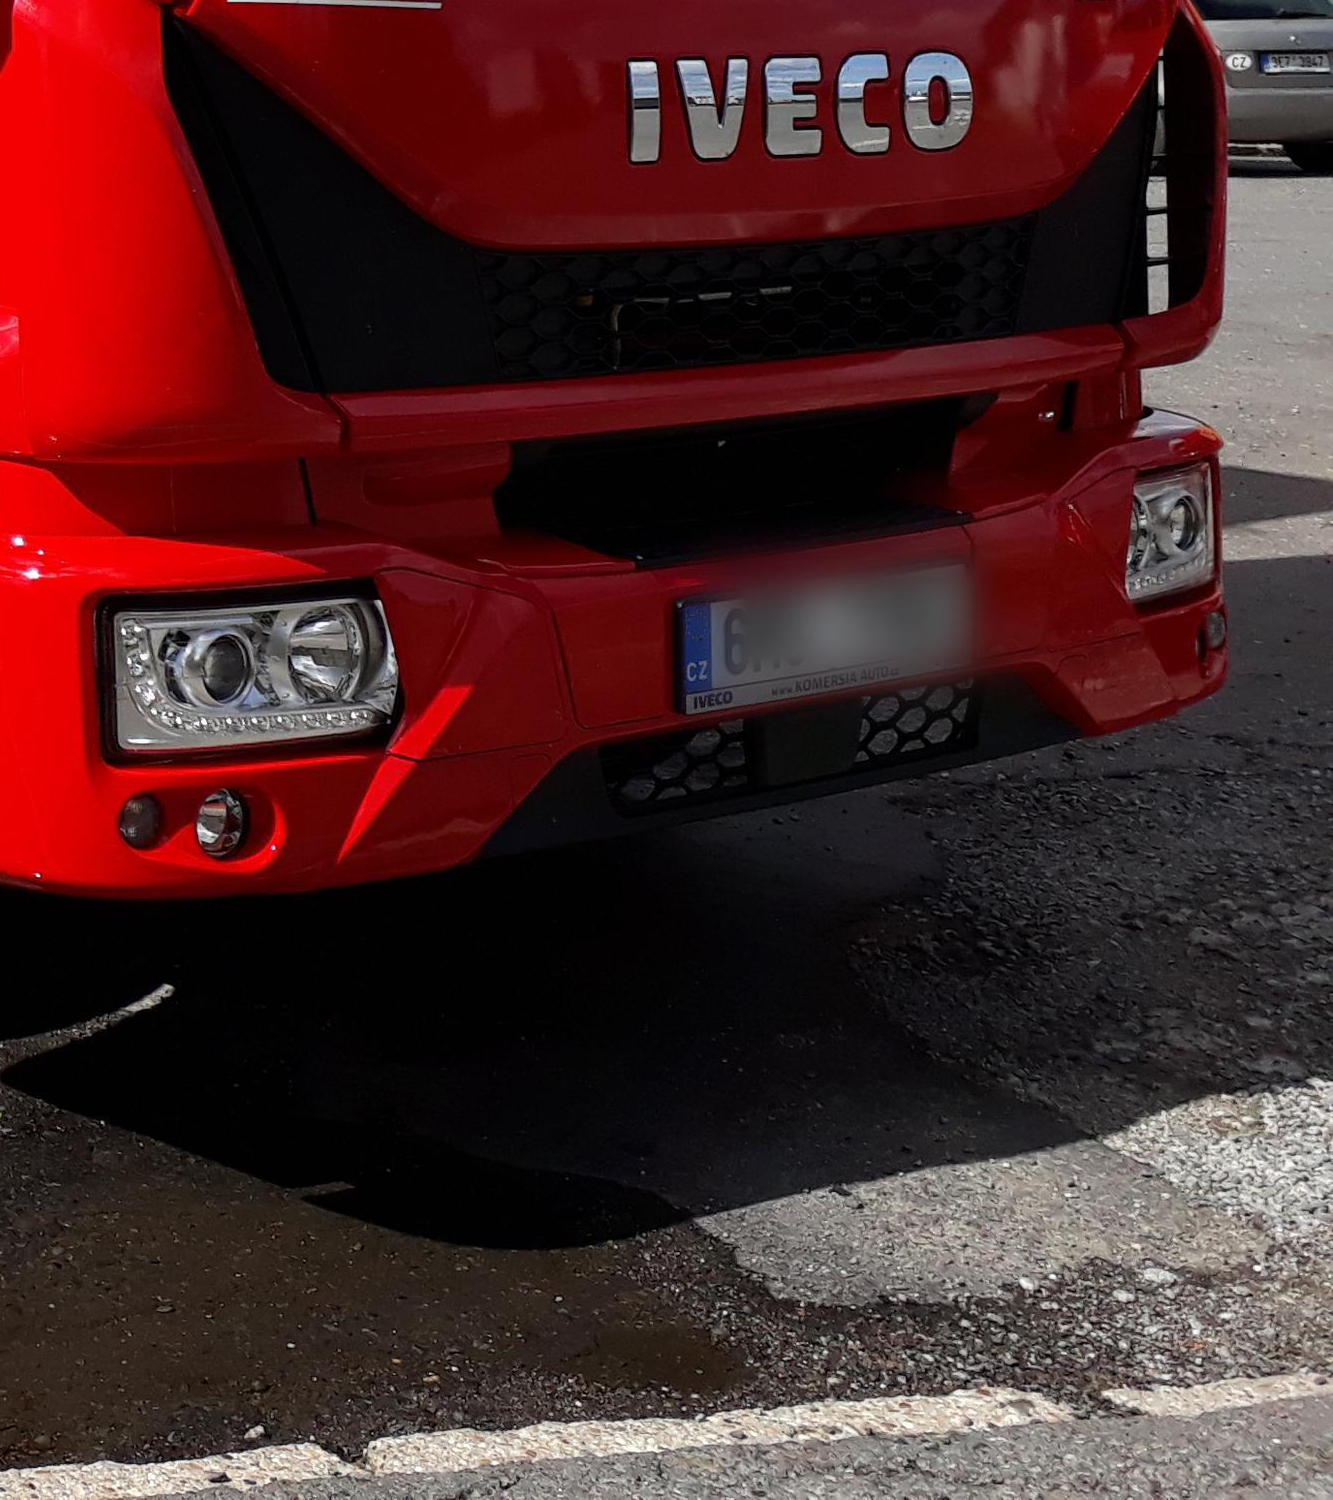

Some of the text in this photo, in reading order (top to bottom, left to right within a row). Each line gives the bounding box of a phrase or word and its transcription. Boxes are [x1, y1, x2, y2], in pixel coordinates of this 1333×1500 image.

[1232, 56, 1246, 68] CZ
[627, 51, 973, 164] IVECO
[686, 660, 708, 682] CZ
[692, 691, 733, 710] IVECO
